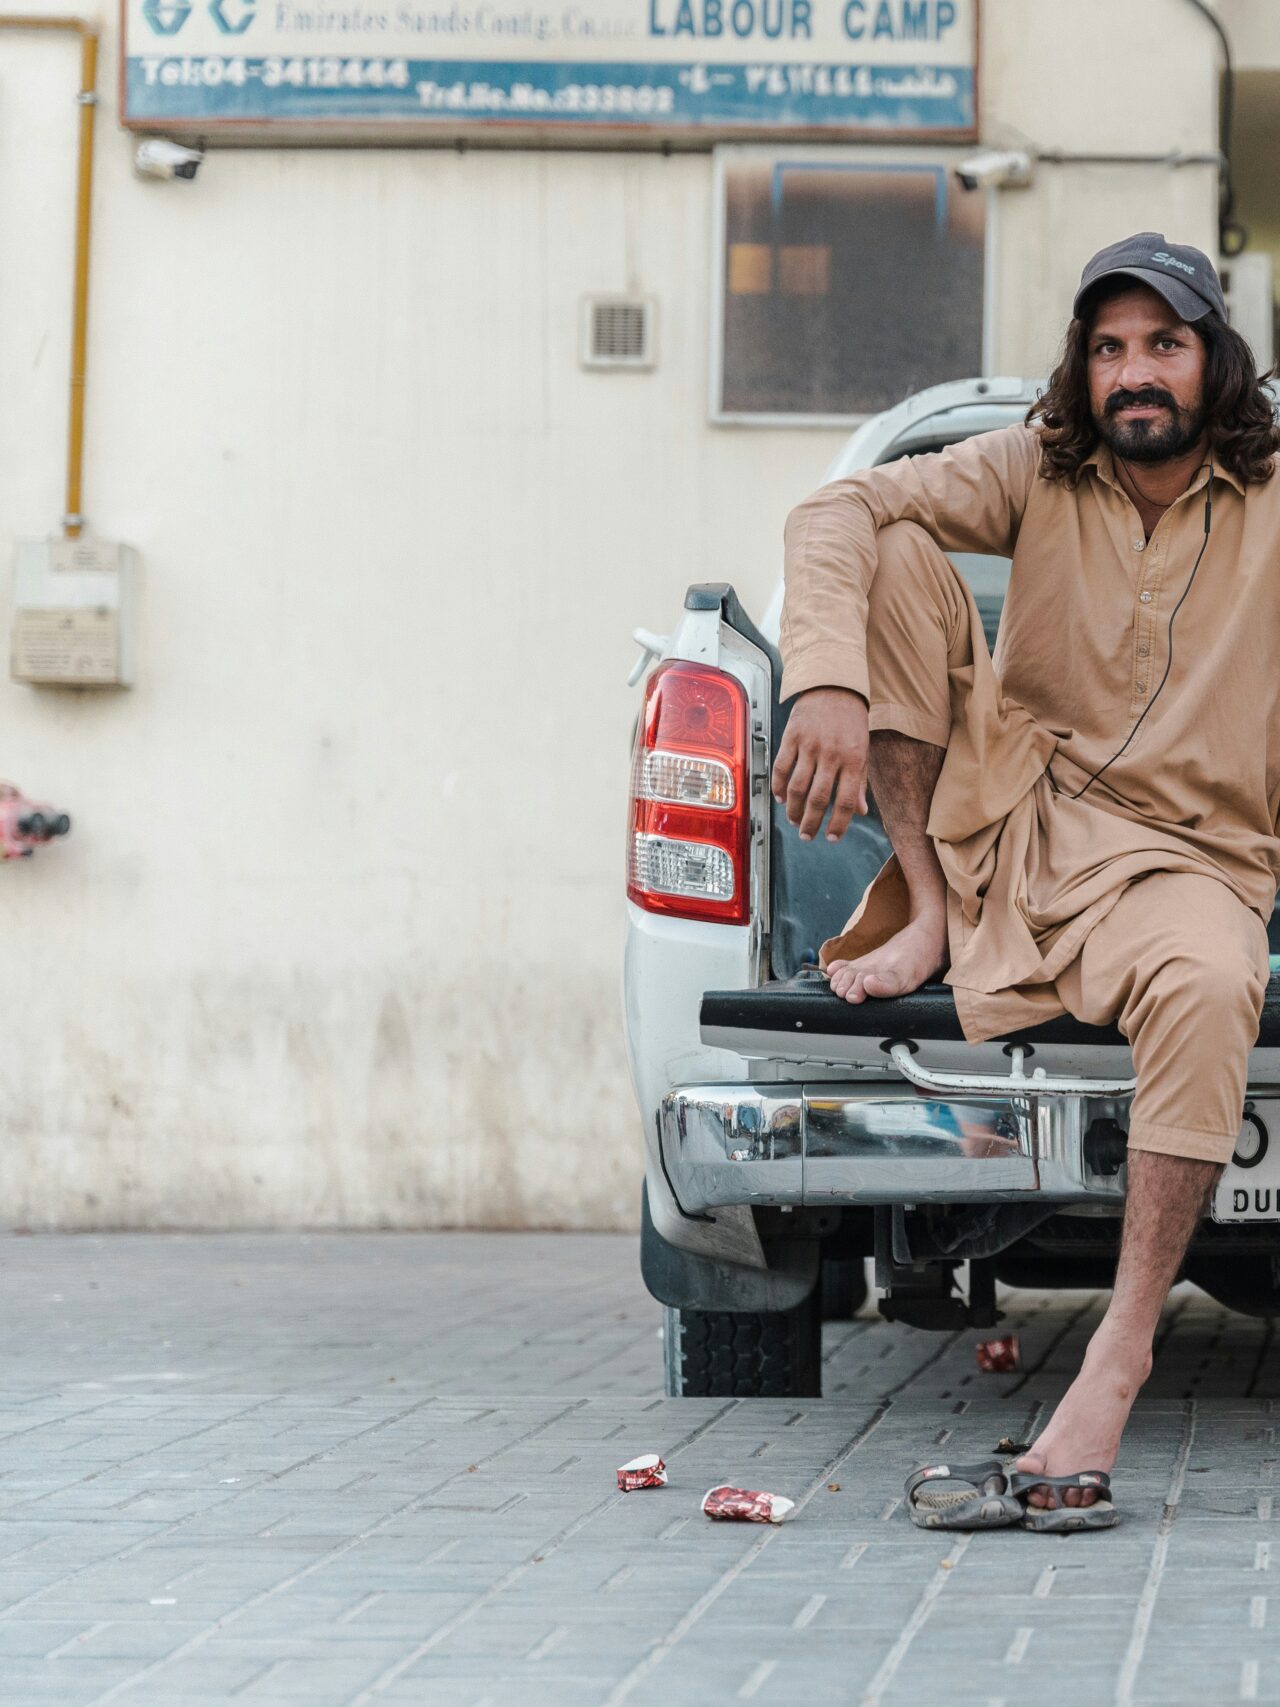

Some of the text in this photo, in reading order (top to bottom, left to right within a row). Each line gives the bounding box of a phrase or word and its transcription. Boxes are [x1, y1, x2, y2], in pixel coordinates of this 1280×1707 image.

[648, 0, 812, 39] LABOUR
[843, 0, 956, 40] CAMP
[1151, 251, 1196, 275] Sport
